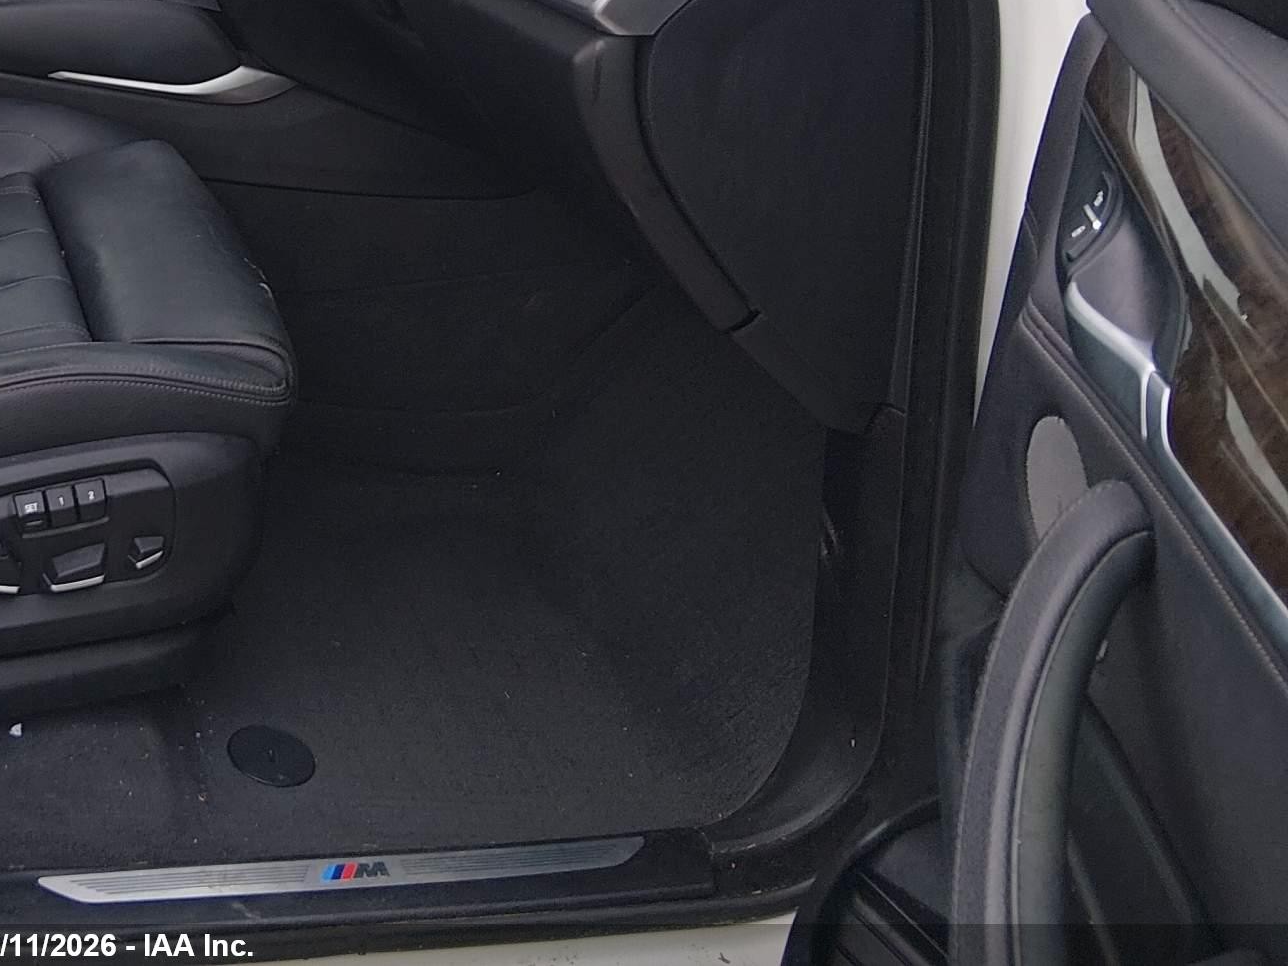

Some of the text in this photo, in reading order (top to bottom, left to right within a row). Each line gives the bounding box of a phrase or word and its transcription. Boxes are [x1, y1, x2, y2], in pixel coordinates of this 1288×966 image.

[88, 490, 95, 500] 2
[58, 496, 64, 506] 1
[24, 502, 38, 514] SET
